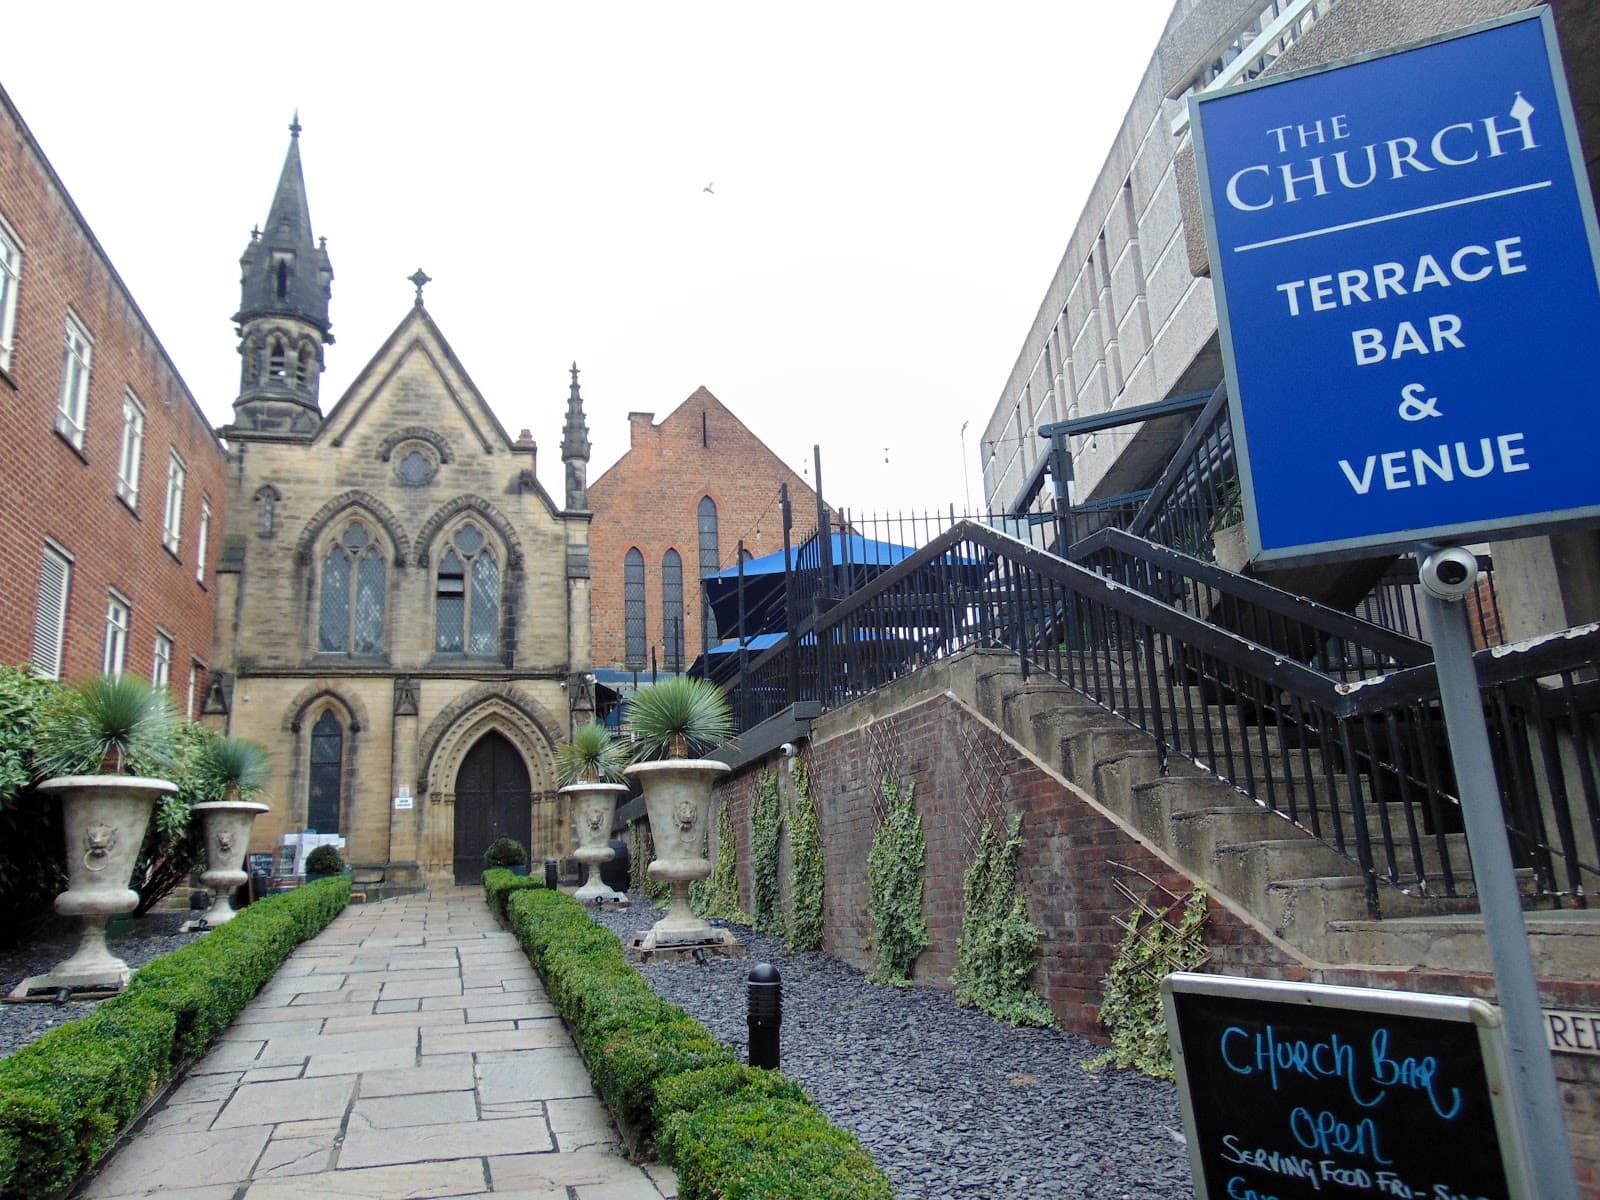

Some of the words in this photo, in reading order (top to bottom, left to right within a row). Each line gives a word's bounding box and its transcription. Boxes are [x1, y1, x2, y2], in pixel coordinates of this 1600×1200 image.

[1225, 92, 1542, 212] CHURCH
[1266, 114, 1350, 153] THE
[1276, 236, 1527, 316] TERRACE
[1351, 313, 1465, 366] BAR
[1398, 382, 1443, 422] &
[1338, 432, 1530, 495] VENUE
